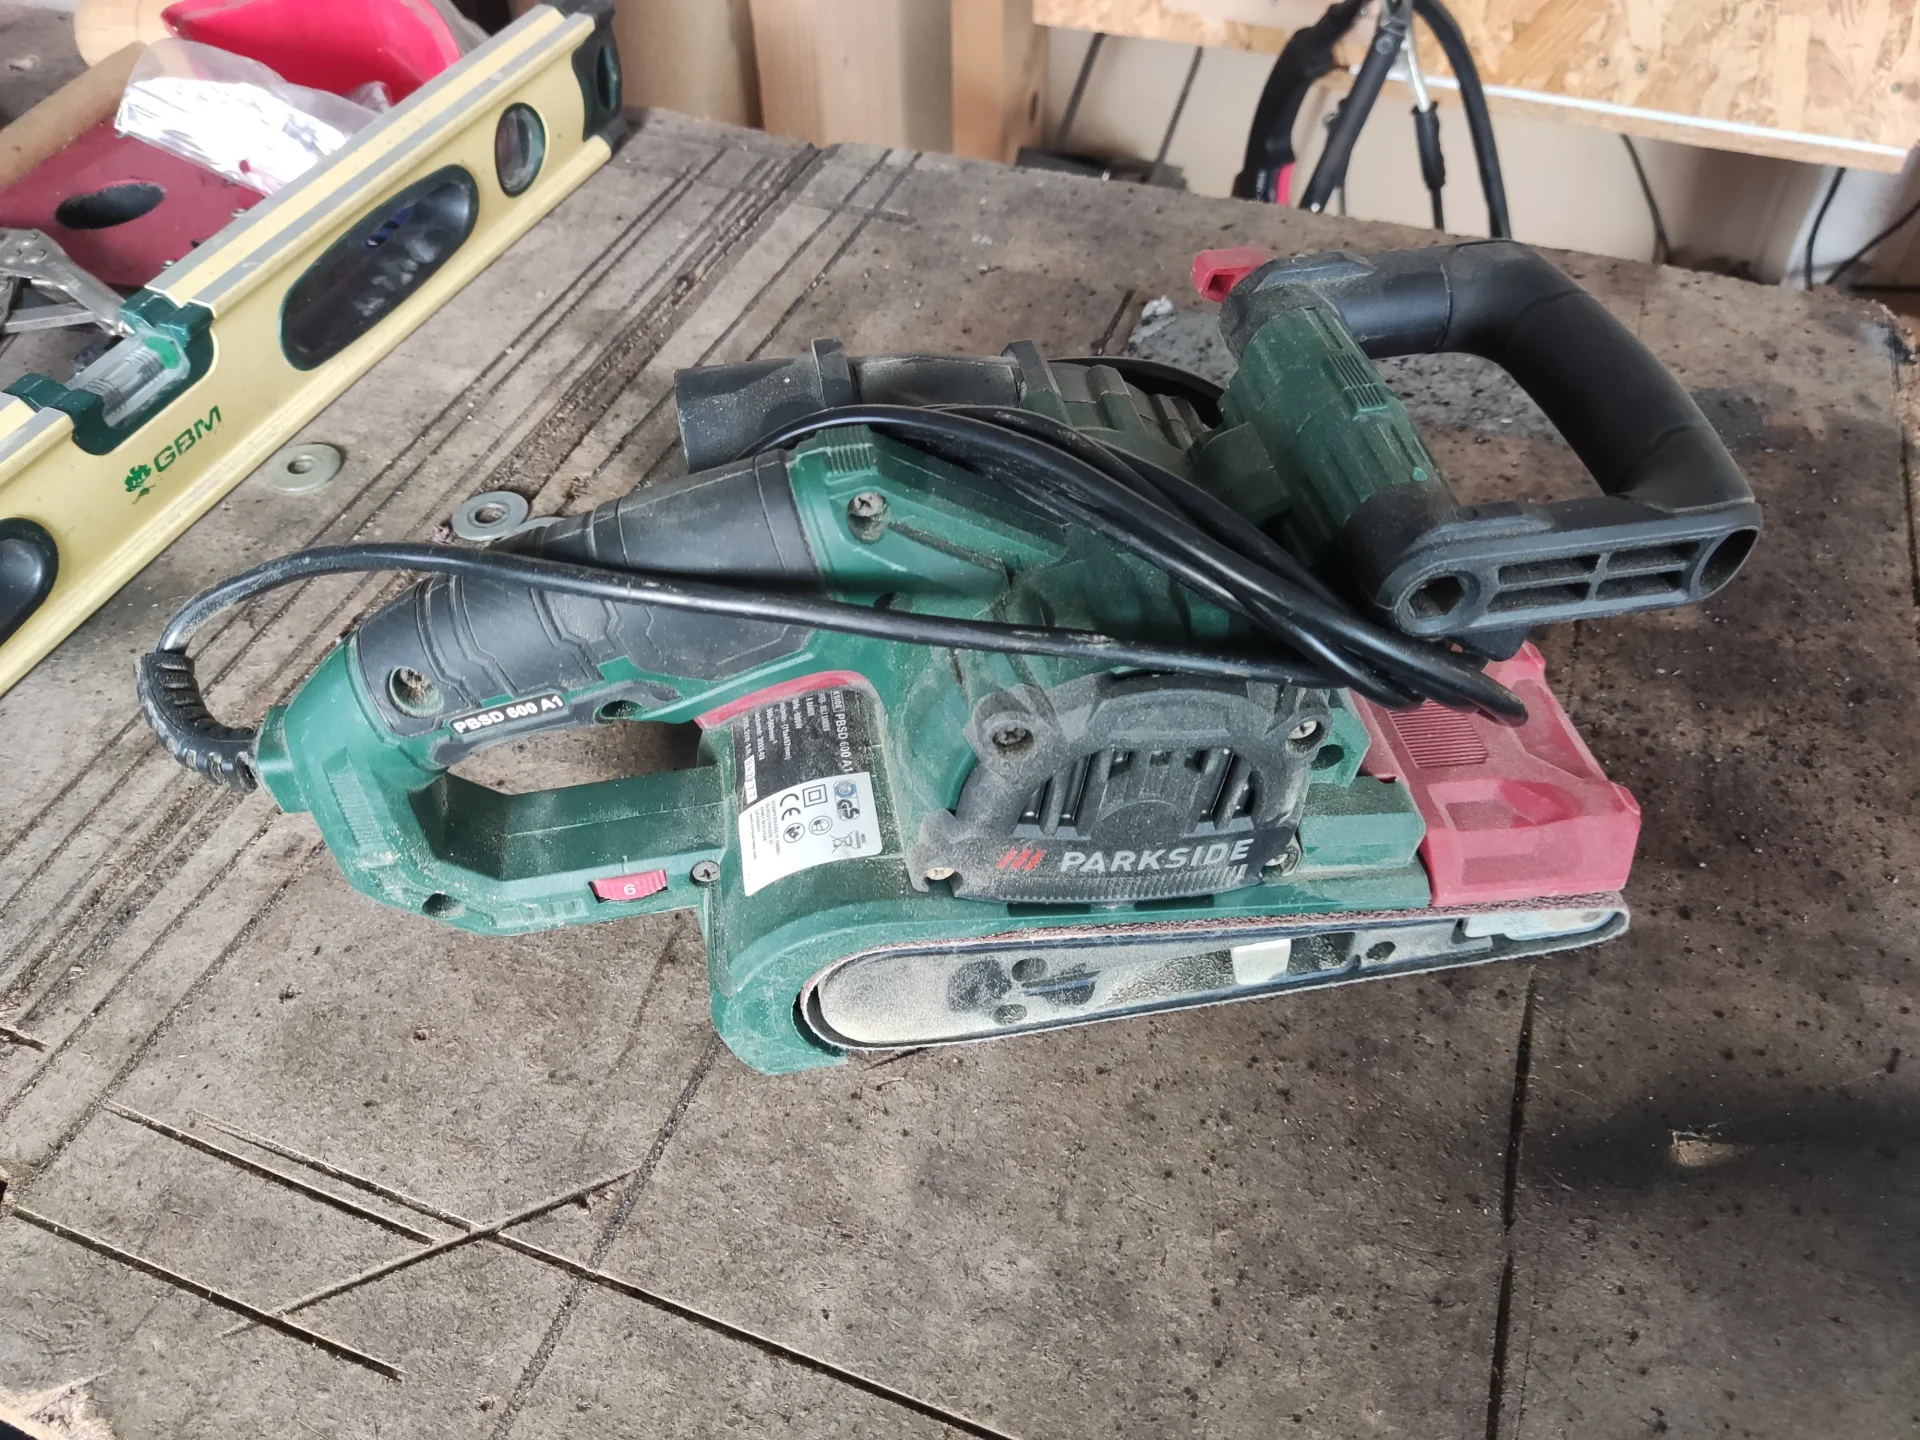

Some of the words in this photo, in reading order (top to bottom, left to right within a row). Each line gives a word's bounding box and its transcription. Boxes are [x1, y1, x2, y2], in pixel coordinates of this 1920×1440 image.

[154, 405, 222, 472] GBM
[453, 711, 505, 734] PBSD
[506, 702, 538, 718] 600
[540, 695, 564, 711] A1
[835, 713, 848, 740] PBSD
[840, 741, 852, 758] 600
[842, 759, 854, 773] A1
[1060, 838, 1254, 872] PARKSIDE
[623, 883, 637, 896] 6
